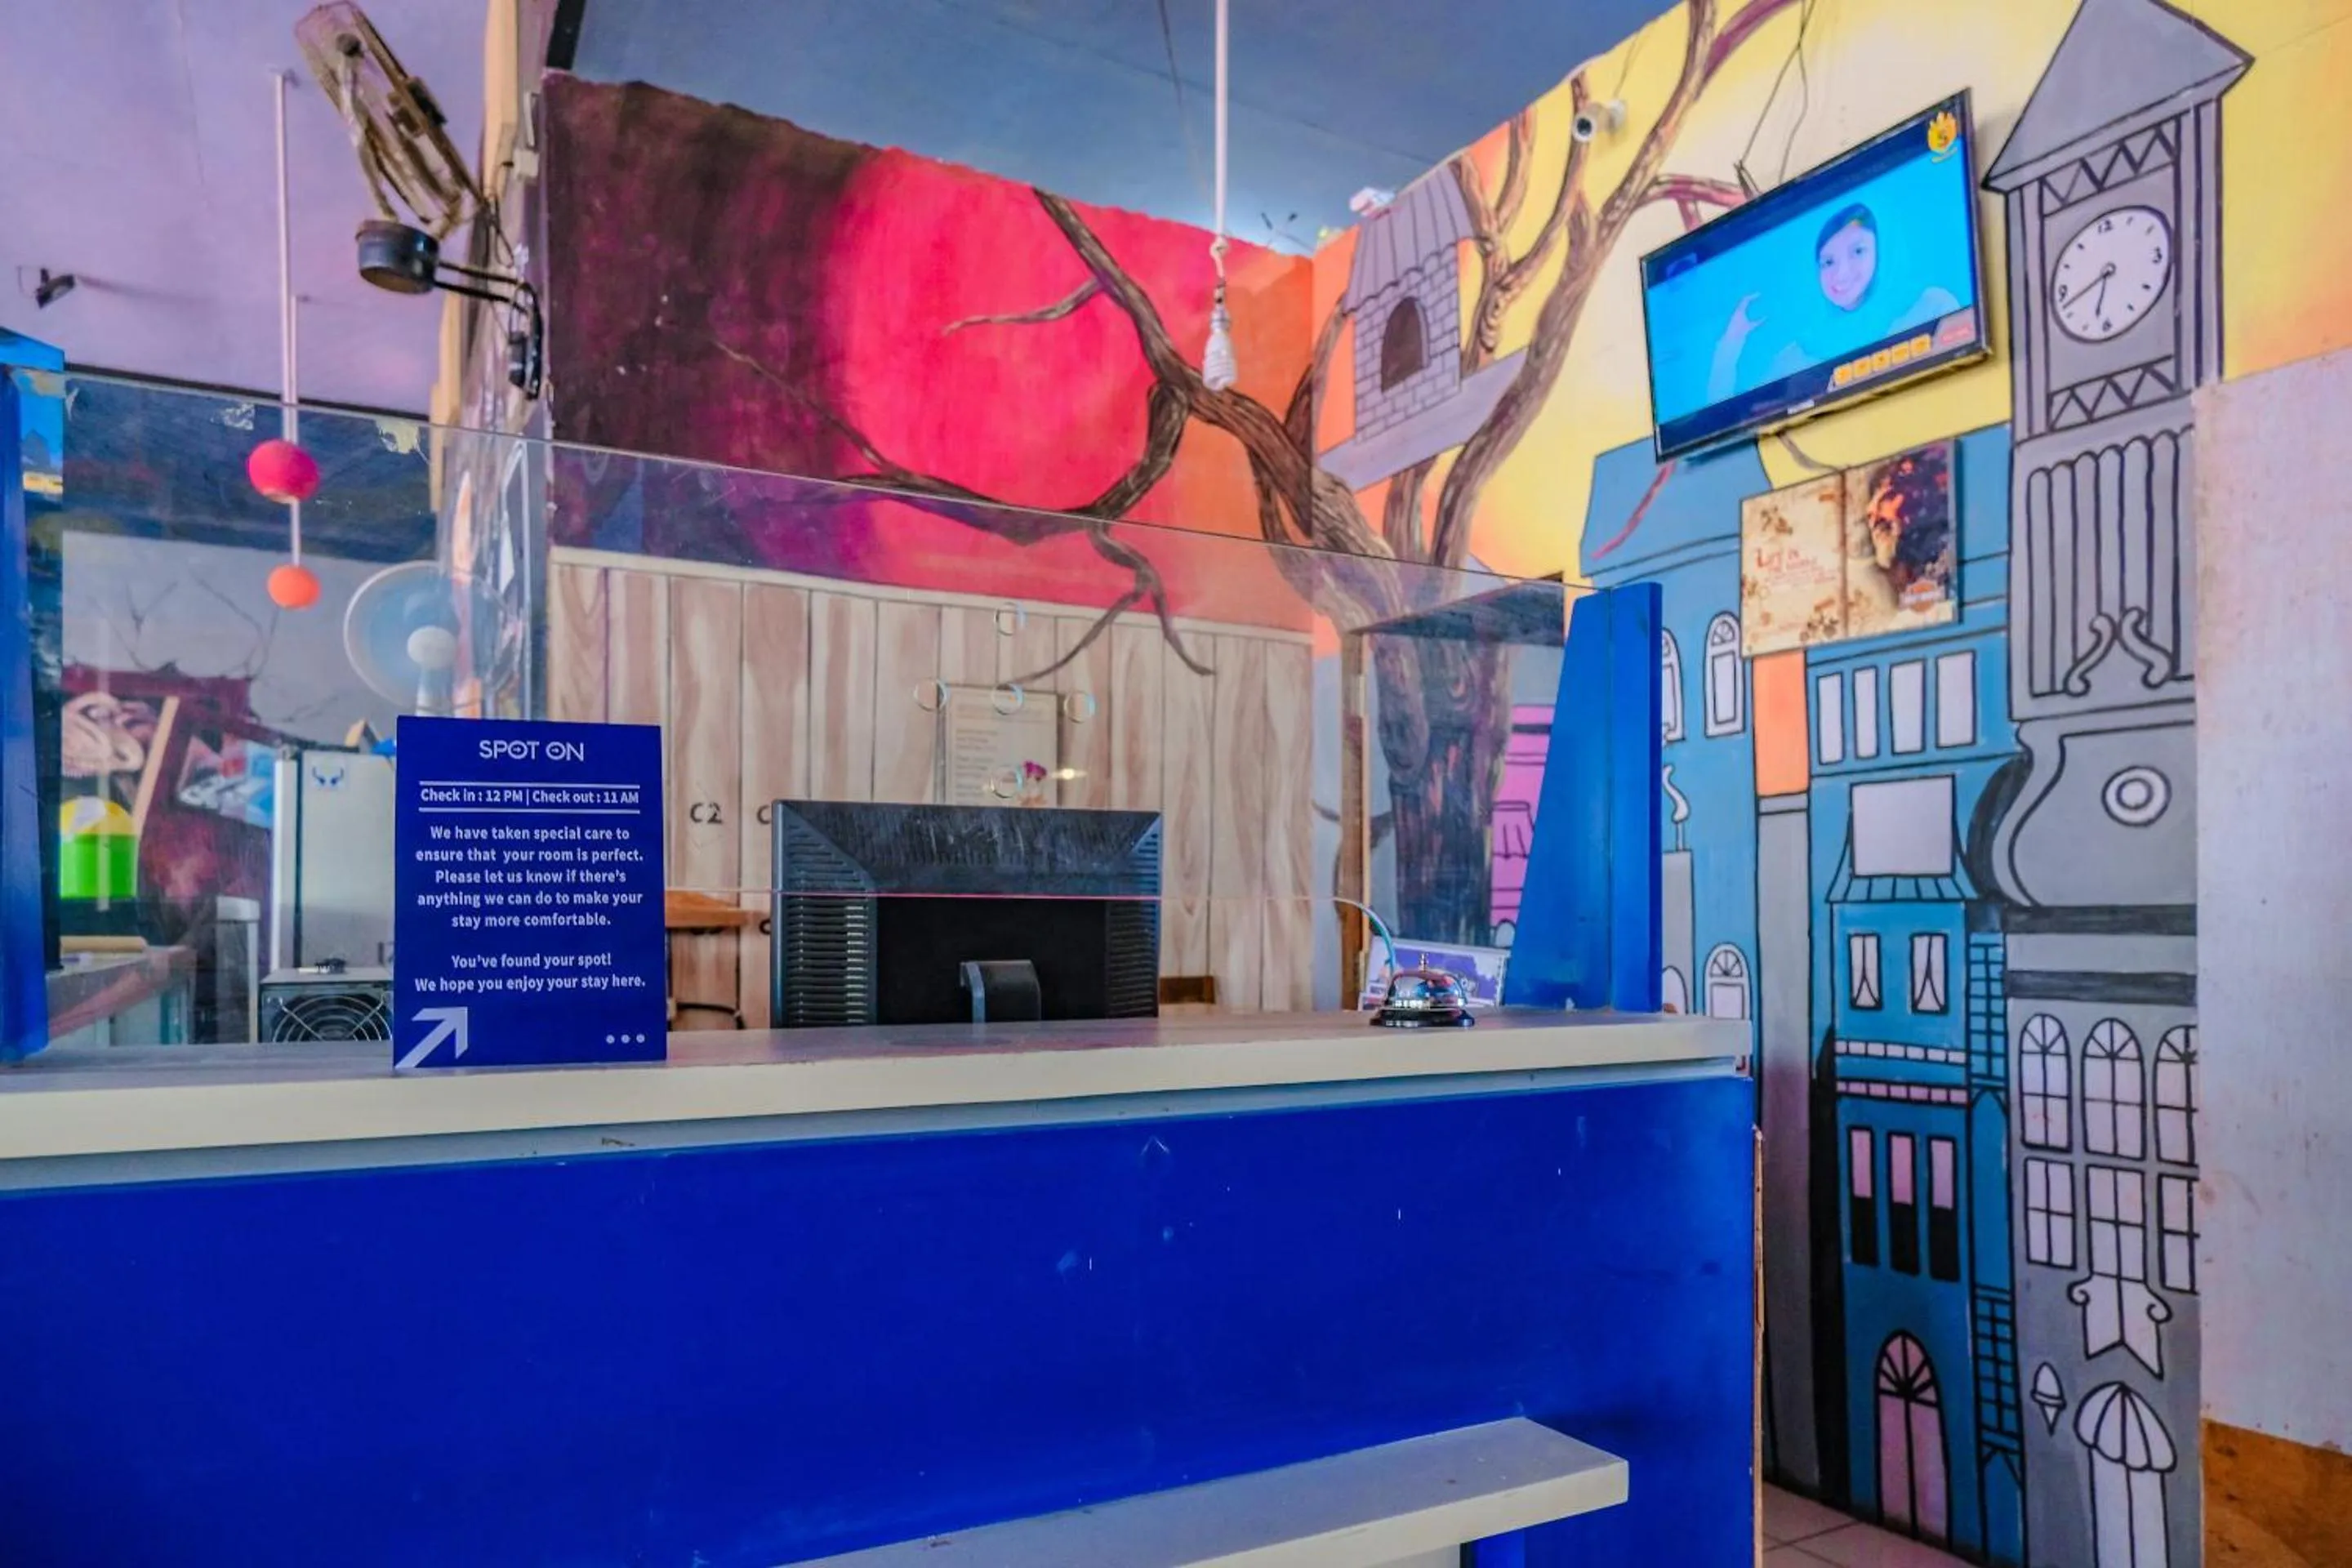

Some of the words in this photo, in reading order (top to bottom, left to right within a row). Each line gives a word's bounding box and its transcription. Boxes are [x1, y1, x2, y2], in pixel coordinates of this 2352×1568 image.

[479, 739, 540, 760] SPOT
[545, 741, 584, 762] ON
[421, 787, 461, 802] Check
[485, 790, 501, 802] 12
[503, 790, 523, 803] PM
[532, 790, 571, 804] Check
[604, 791, 618, 804] 11
[620, 791, 639, 804] AM
[689, 801, 723, 825] C2
[430, 826, 452, 840] We
[455, 826, 488, 840] have
[491, 826, 530, 840] taken
[533, 826, 581, 843] special
[584, 829, 613, 840] care
[616, 827, 630, 840] to
[415, 850, 464, 862] ensure
[466, 848, 497, 862] that
[502, 850, 535, 864] your
[538, 850, 573, 862] room
[577, 848, 589, 862] is
[591, 848, 644, 864] perfect.
[435, 869, 481, 884] Please
[484, 869, 504, 884] let
[506, 872, 523, 883] us
[526, 869, 563, 883] know
[566, 869, 577, 883] if
[417, 891, 481, 909] anything
[483, 894, 504, 905] we
[507, 894, 532, 905] can
[535, 890, 553, 905] do
[555, 892, 570, 905] to
[572, 890, 609, 904] make
[612, 893, 644, 906] your
[452, 915, 481, 930] stay
[484, 915, 521, 927] more
[523, 911, 612, 927] comfortable.
[501, 953, 541, 968] found
[543, 956, 575, 969] your
[577, 952, 612, 969] spot!
[414, 978, 437, 992] We
[439, 977, 474, 994] hope
[477, 978, 503, 993] you
[506, 975, 545, 992] enjoy
[546, 978, 578, 991] your
[581, 975, 609, 991] stay
[612, 973, 646, 987] here.
